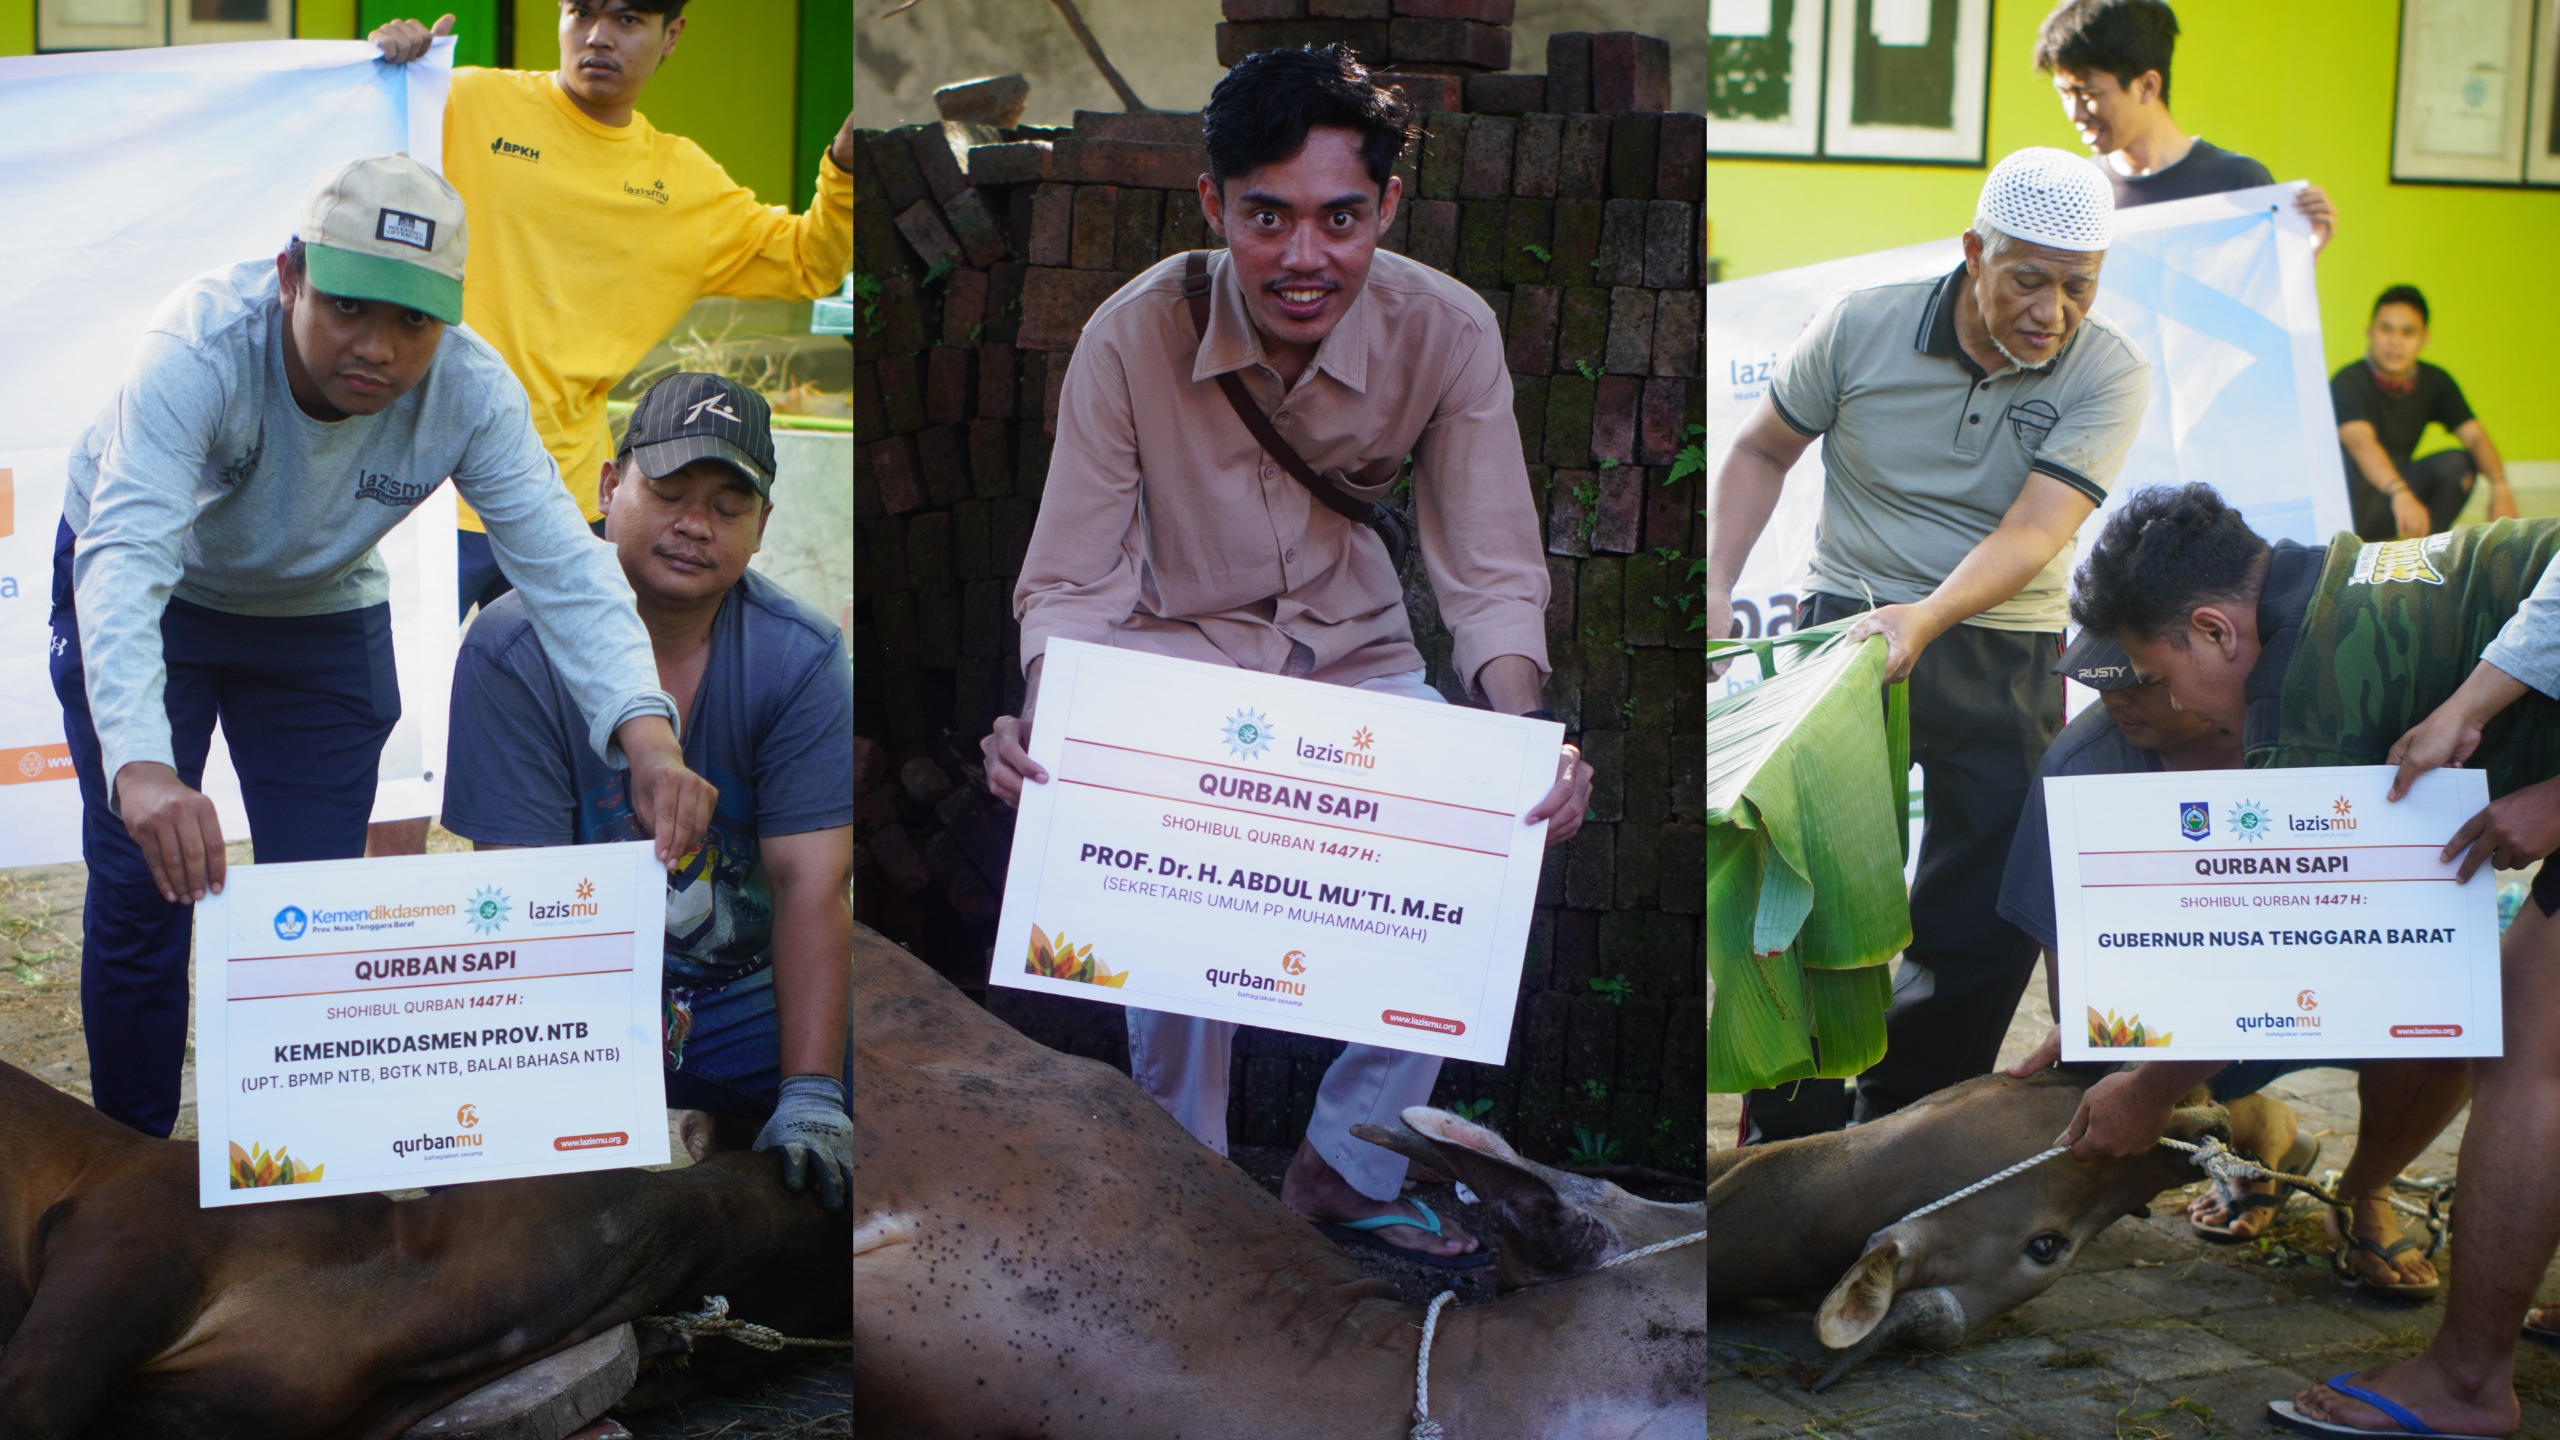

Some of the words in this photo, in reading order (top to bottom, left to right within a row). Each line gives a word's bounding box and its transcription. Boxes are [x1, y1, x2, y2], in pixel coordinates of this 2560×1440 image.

[503, 141, 540, 160] BPKH
[623, 181, 670, 202] lazismu
[2077, 666, 2126, 680] RUSTY
[1296, 736, 1375, 770] lazismu
[1198, 773, 1313, 811] QURBAN
[1316, 793, 1379, 823] SAPI
[2288, 814, 2357, 832] lazismu
[1161, 814, 1242, 840] SHOHIBUL
[1247, 829, 1315, 851] QURBAN
[1319, 841, 1360, 859] 1447
[2194, 856, 2292, 876] QURBAN
[2295, 855, 2349, 873] SAPI
[1080, 842, 1153, 874] PROF.
[1158, 856, 1193, 880] Dr.
[1197, 863, 1223, 886] H.
[1227, 868, 1313, 901] ABDUL
[1400, 897, 1464, 926] M.Ed
[529, 900, 598, 920] lazismu
[1102, 875, 1203, 905] (SEKRETARIS
[1207, 893, 1260, 915] UMUM
[1263, 902, 1284, 918] PP
[1287, 907, 1428, 944] MUHAMMADIYAH)
[2179, 896, 2249, 908] SHOHIBUL
[2252, 895, 2310, 907] QURBAN
[2313, 894, 2348, 906] 1447
[312, 903, 456, 924] Kemendikdasmen
[334, 924, 354, 933] Nusa
[356, 922, 393, 931] Tenggara
[394, 920, 415, 929] Barat
[2098, 931, 2205, 948] GUBERNUR
[2209, 931, 2264, 947] NUSA
[2268, 929, 2382, 946] TENGGARA
[2386, 928, 2456, 944] BARAT
[355, 954, 457, 981] QURBAN
[461, 950, 516, 973] SAPI
[1205, 968, 1306, 997] qurbanmu
[326, 1003, 400, 1020] SHOHIBUL
[404, 997, 465, 1014] QURBAN
[469, 994, 504, 1009] 1447
[1237, 990, 1276, 1003] bahagiakan
[1277, 998, 1303, 1007] sesama
[1389, 1014, 1457, 1034] www.lazismu.org
[2236, 1012, 2321, 1033] qurbanmu
[274, 1030, 477, 1063] KEMENDIKDASMEN
[482, 1025, 543, 1046] PROV.
[547, 1021, 589, 1041] NTB
[241, 1075, 284, 1094] (UPT.
[288, 1071, 334, 1088] BPMP
[338, 1068, 375, 1084] NTB,
[380, 1064, 422, 1080] BGTK
[426, 1061, 463, 1076] NTB,
[467, 1056, 512, 1073] BALAI
[516, 1051, 580, 1069] BAHASA
[584, 1047, 620, 1063] NTB)
[392, 1133, 483, 1158] qurbanmu
[560, 1136, 621, 1148] www.lazismu.org
[460, 1150, 483, 1158] sesama
